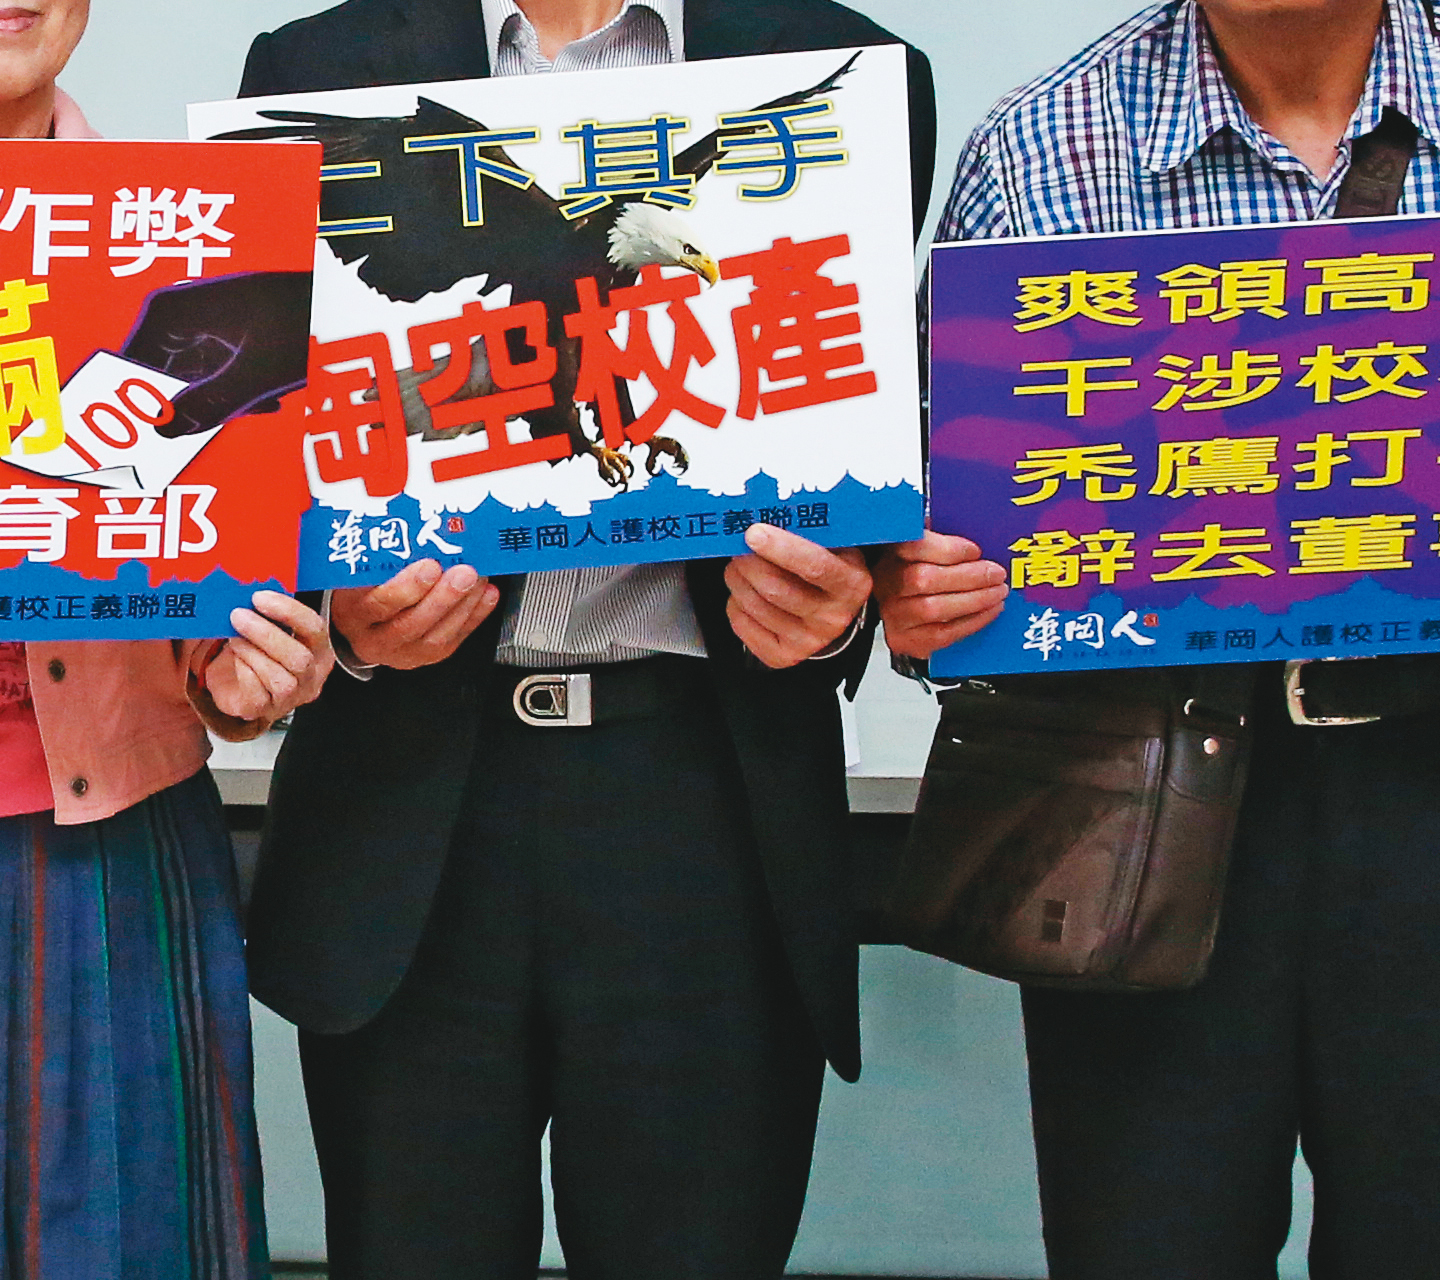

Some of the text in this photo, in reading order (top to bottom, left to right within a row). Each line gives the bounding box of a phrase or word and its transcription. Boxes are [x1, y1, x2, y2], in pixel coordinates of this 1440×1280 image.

[328, 510, 463, 574] 華岡人
[498, 502, 829, 552] 華岡人護校正義聯盟
[1023, 608, 1156, 661] 華岡人
